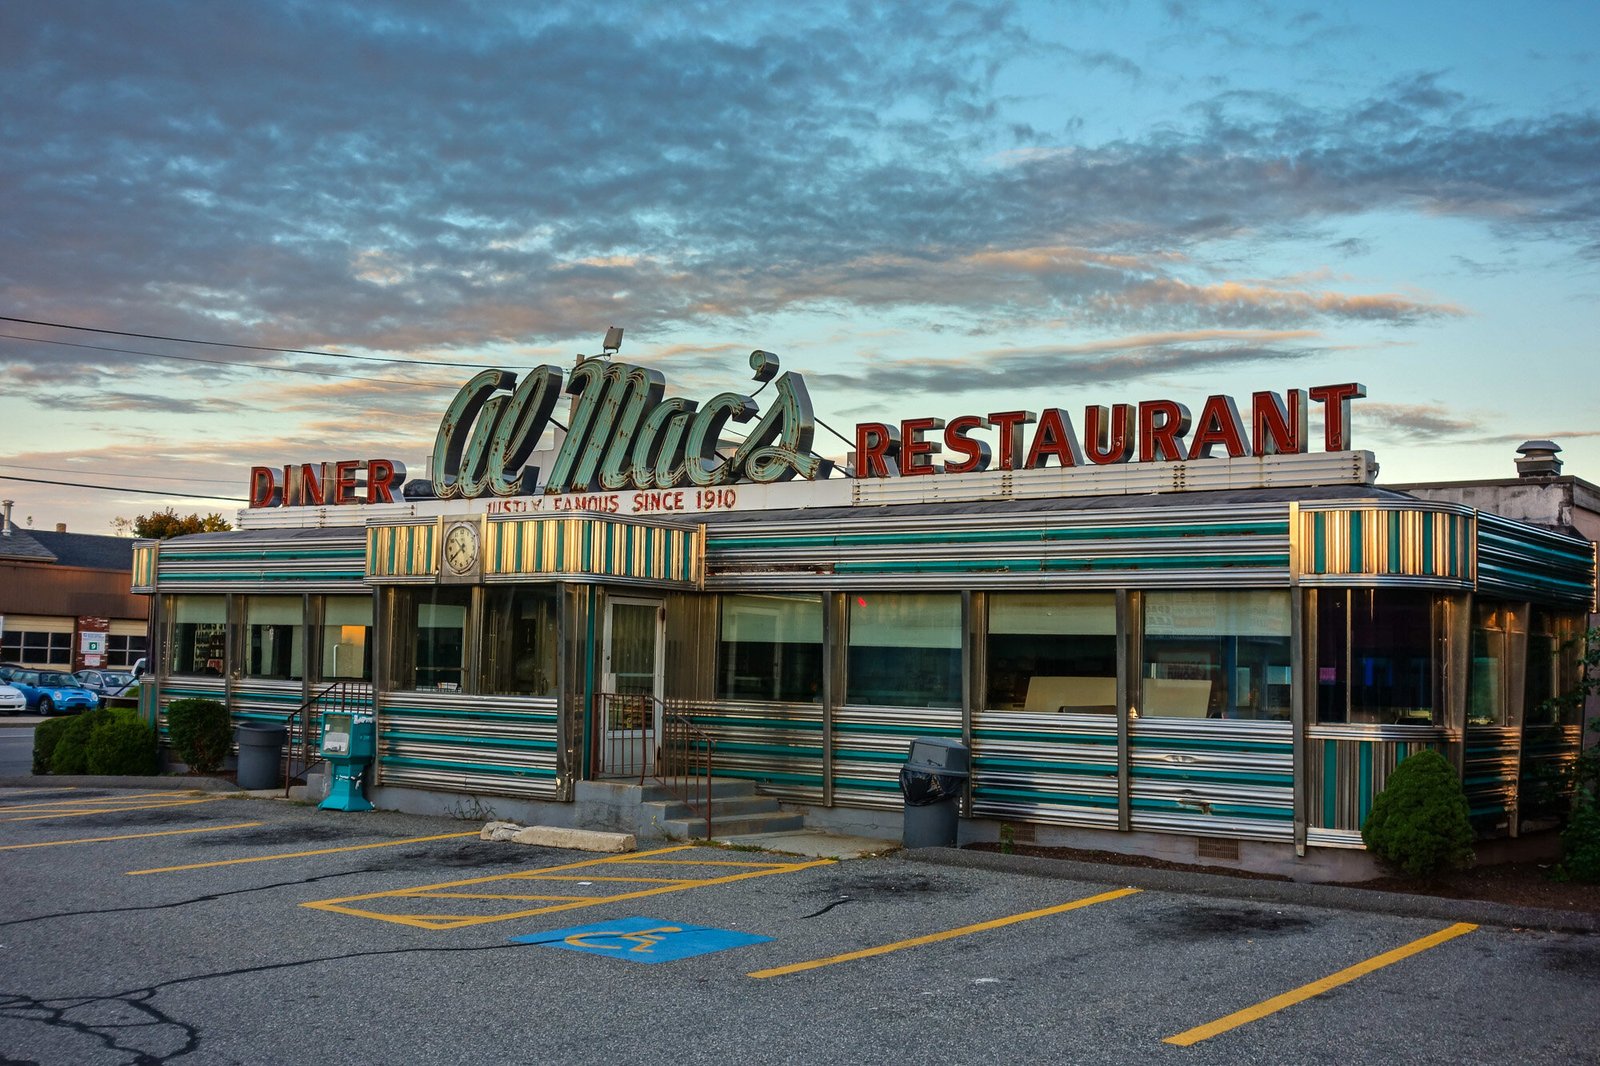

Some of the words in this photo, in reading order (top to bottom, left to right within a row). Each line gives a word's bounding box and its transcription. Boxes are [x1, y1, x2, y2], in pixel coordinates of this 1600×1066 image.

[546, 350, 826, 494] Mac's
[856, 382, 1362, 478] RESTAURANT
[249, 459, 400, 509] DINER
[553, 494, 620, 513] FAMOUS
[632, 491, 685, 512] SINCE
[697, 489, 736, 509] 1910
